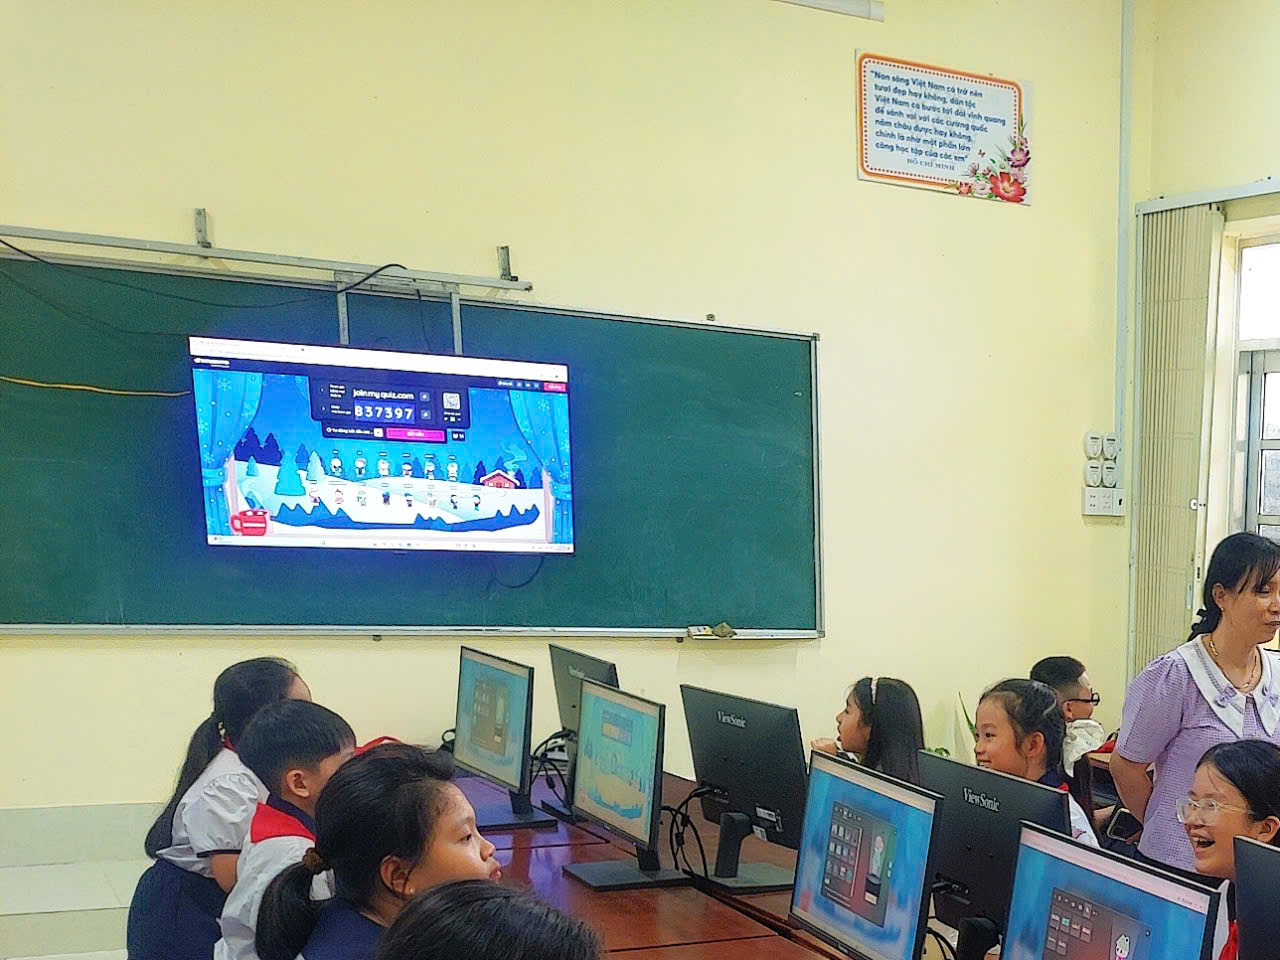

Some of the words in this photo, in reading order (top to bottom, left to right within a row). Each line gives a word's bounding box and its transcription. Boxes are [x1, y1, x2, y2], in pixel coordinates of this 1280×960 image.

[928, 82, 946, 91] Nam
[892, 98, 910, 107] Nam
[963, 787, 1001, 812] ViewSonic
